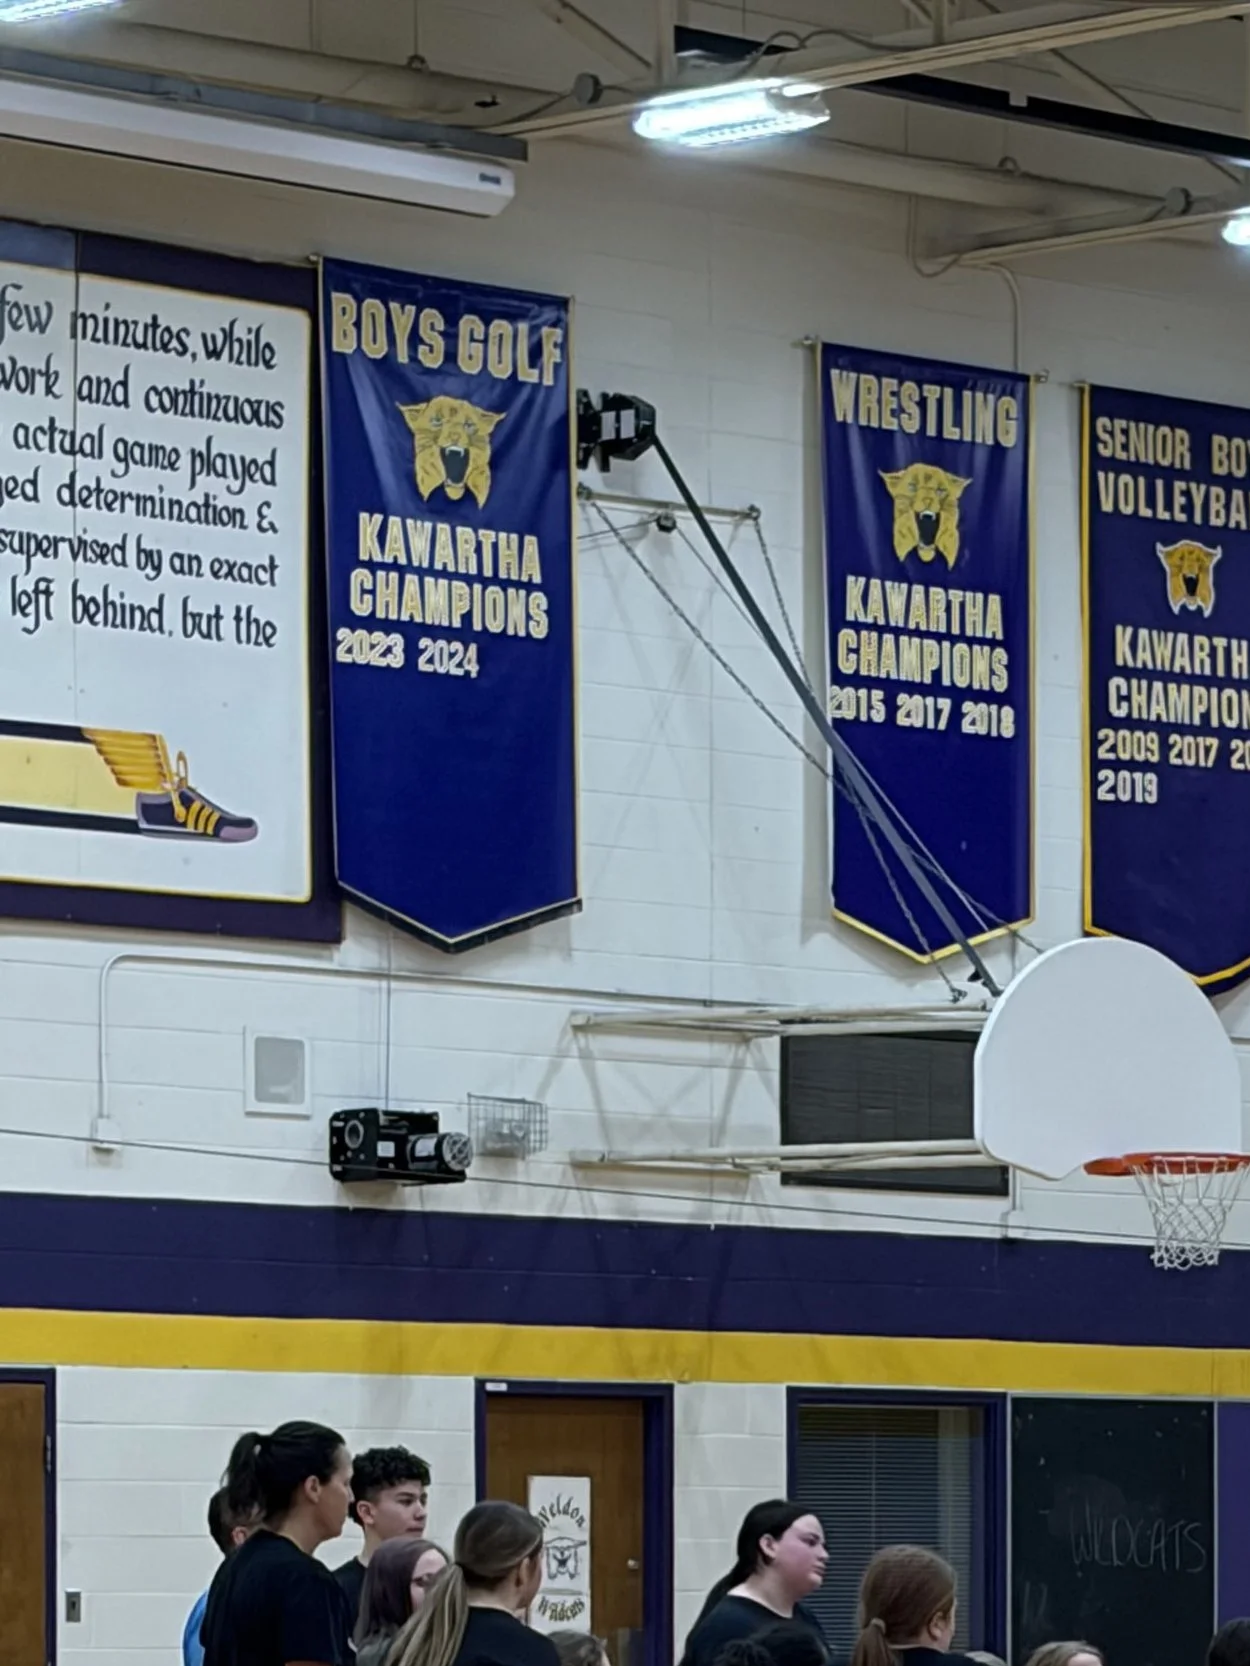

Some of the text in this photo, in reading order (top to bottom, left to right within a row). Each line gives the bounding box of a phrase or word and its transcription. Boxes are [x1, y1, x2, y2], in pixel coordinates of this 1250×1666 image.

[0, 283, 53, 346] few
[201, 317, 278, 371] while
[331, 291, 563, 386] BOYS GOLF
[77, 362, 131, 410] and
[144, 378, 285, 430] continuous
[829, 368, 1018, 448] WRESTLING
[13, 415, 278, 496] actual game played
[1095, 416, 1191, 472] SENIOR
[0, 464, 279, 535] ed determination &
[0, 526, 280, 588] supervised by an exact
[357, 511, 543, 585] KAWARTHA
[10, 574, 56, 636] left
[182, 595, 225, 642] but
[233, 604, 278, 649] the
[349, 567, 550, 640] CHAMPIONS
[845, 574, 1004, 641] KAWARTHA
[335, 627, 480, 679] 2023 2024
[837, 628, 1010, 694] CHAMPIONS
[829, 685, 1016, 739] 2015 2017 2018
[1097, 728, 1161, 764] 2009
[1168, 733, 1220, 768] 2017
[1097, 768, 1159, 805] 2019
